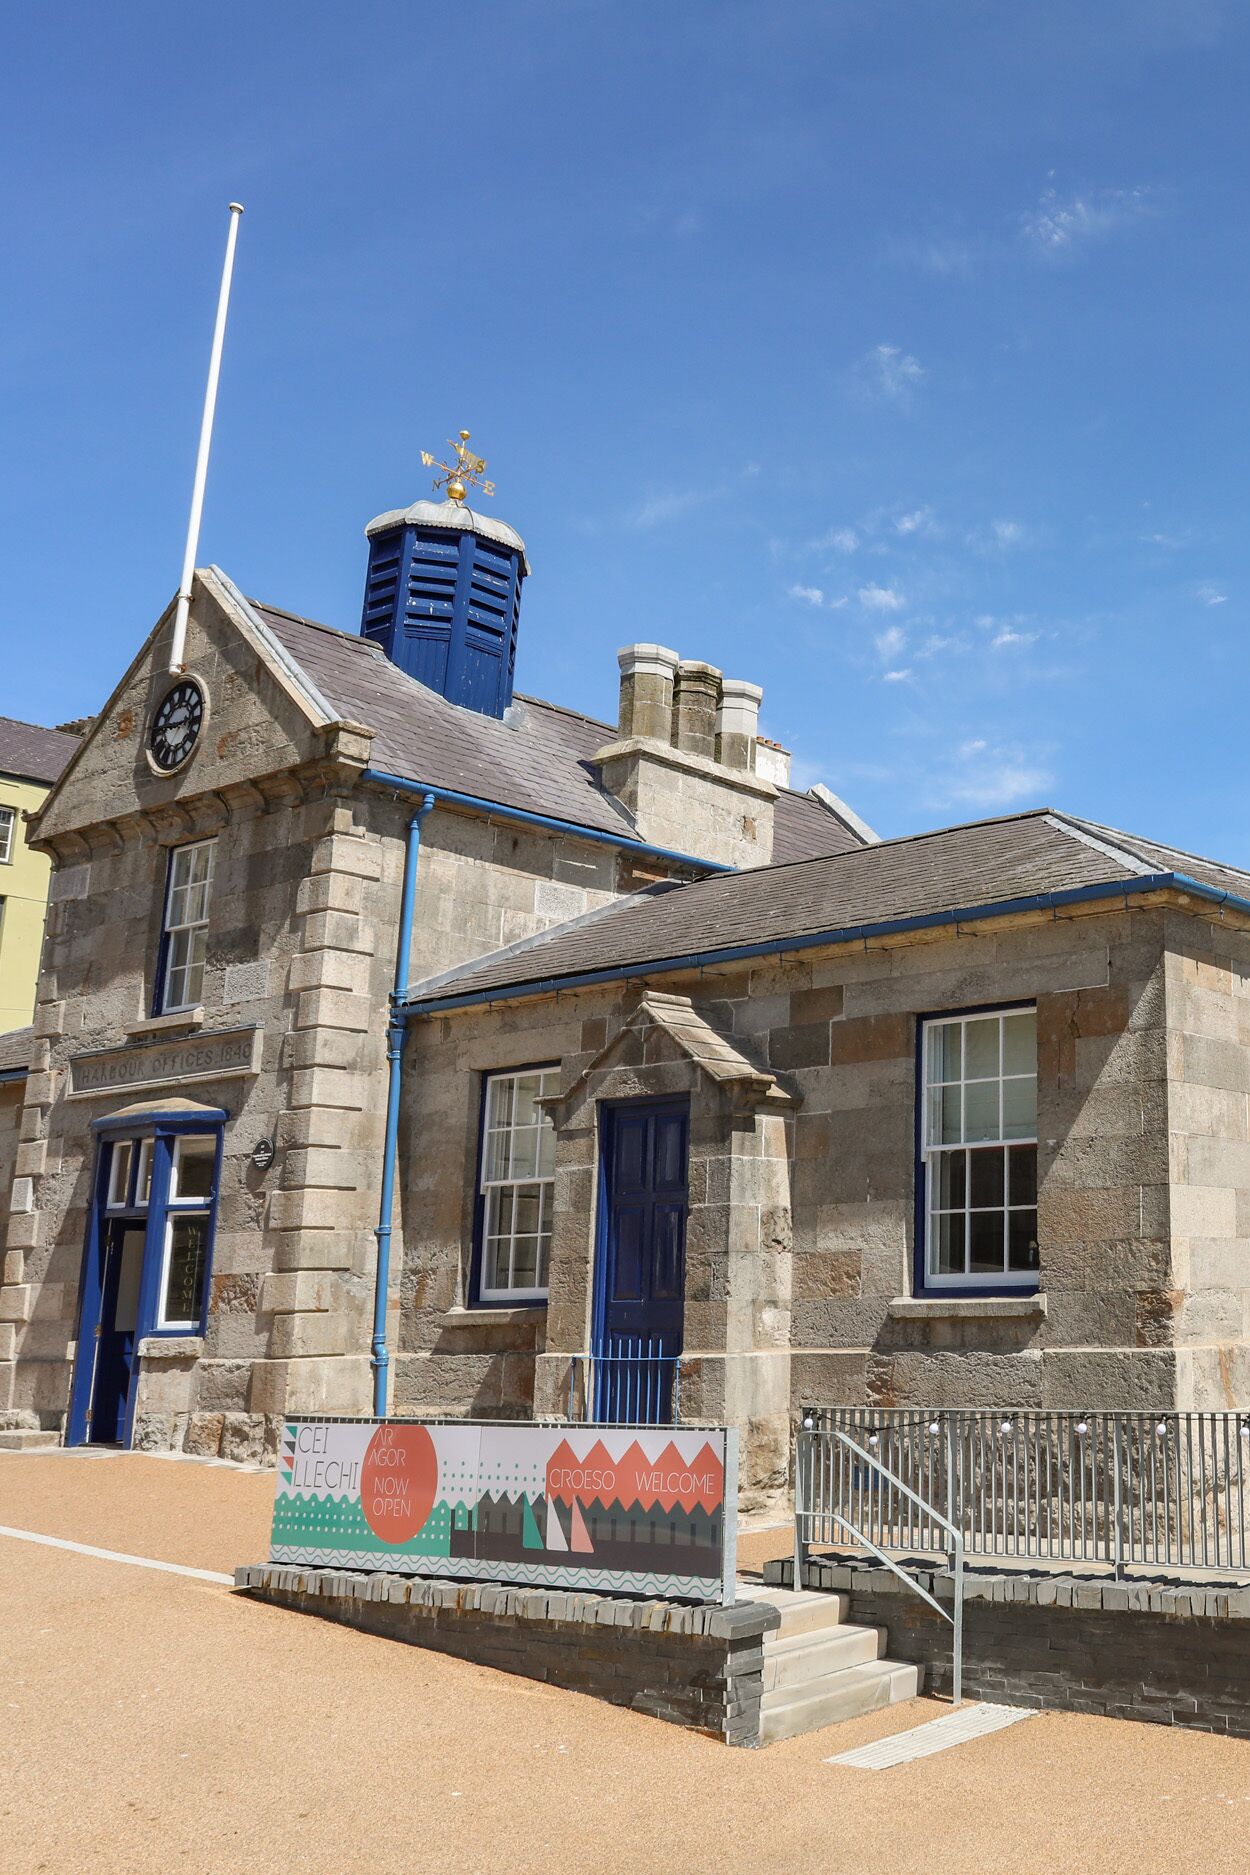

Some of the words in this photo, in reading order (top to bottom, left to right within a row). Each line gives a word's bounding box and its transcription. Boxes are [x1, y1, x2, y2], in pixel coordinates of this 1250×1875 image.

[81, 1060, 144, 1084] HARBOUR
[182, 1226, 198, 1312] WELCOME
[298, 1426, 330, 1454] CEI
[373, 1428, 394, 1446] AR
[367, 1448, 406, 1467] AGOR
[293, 1460, 359, 1490] LLECHI
[373, 1476, 409, 1496] NOW
[549, 1468, 616, 1490] CROESO
[635, 1471, 715, 1494] WELCOME
[372, 1497, 411, 1517] OPEN
